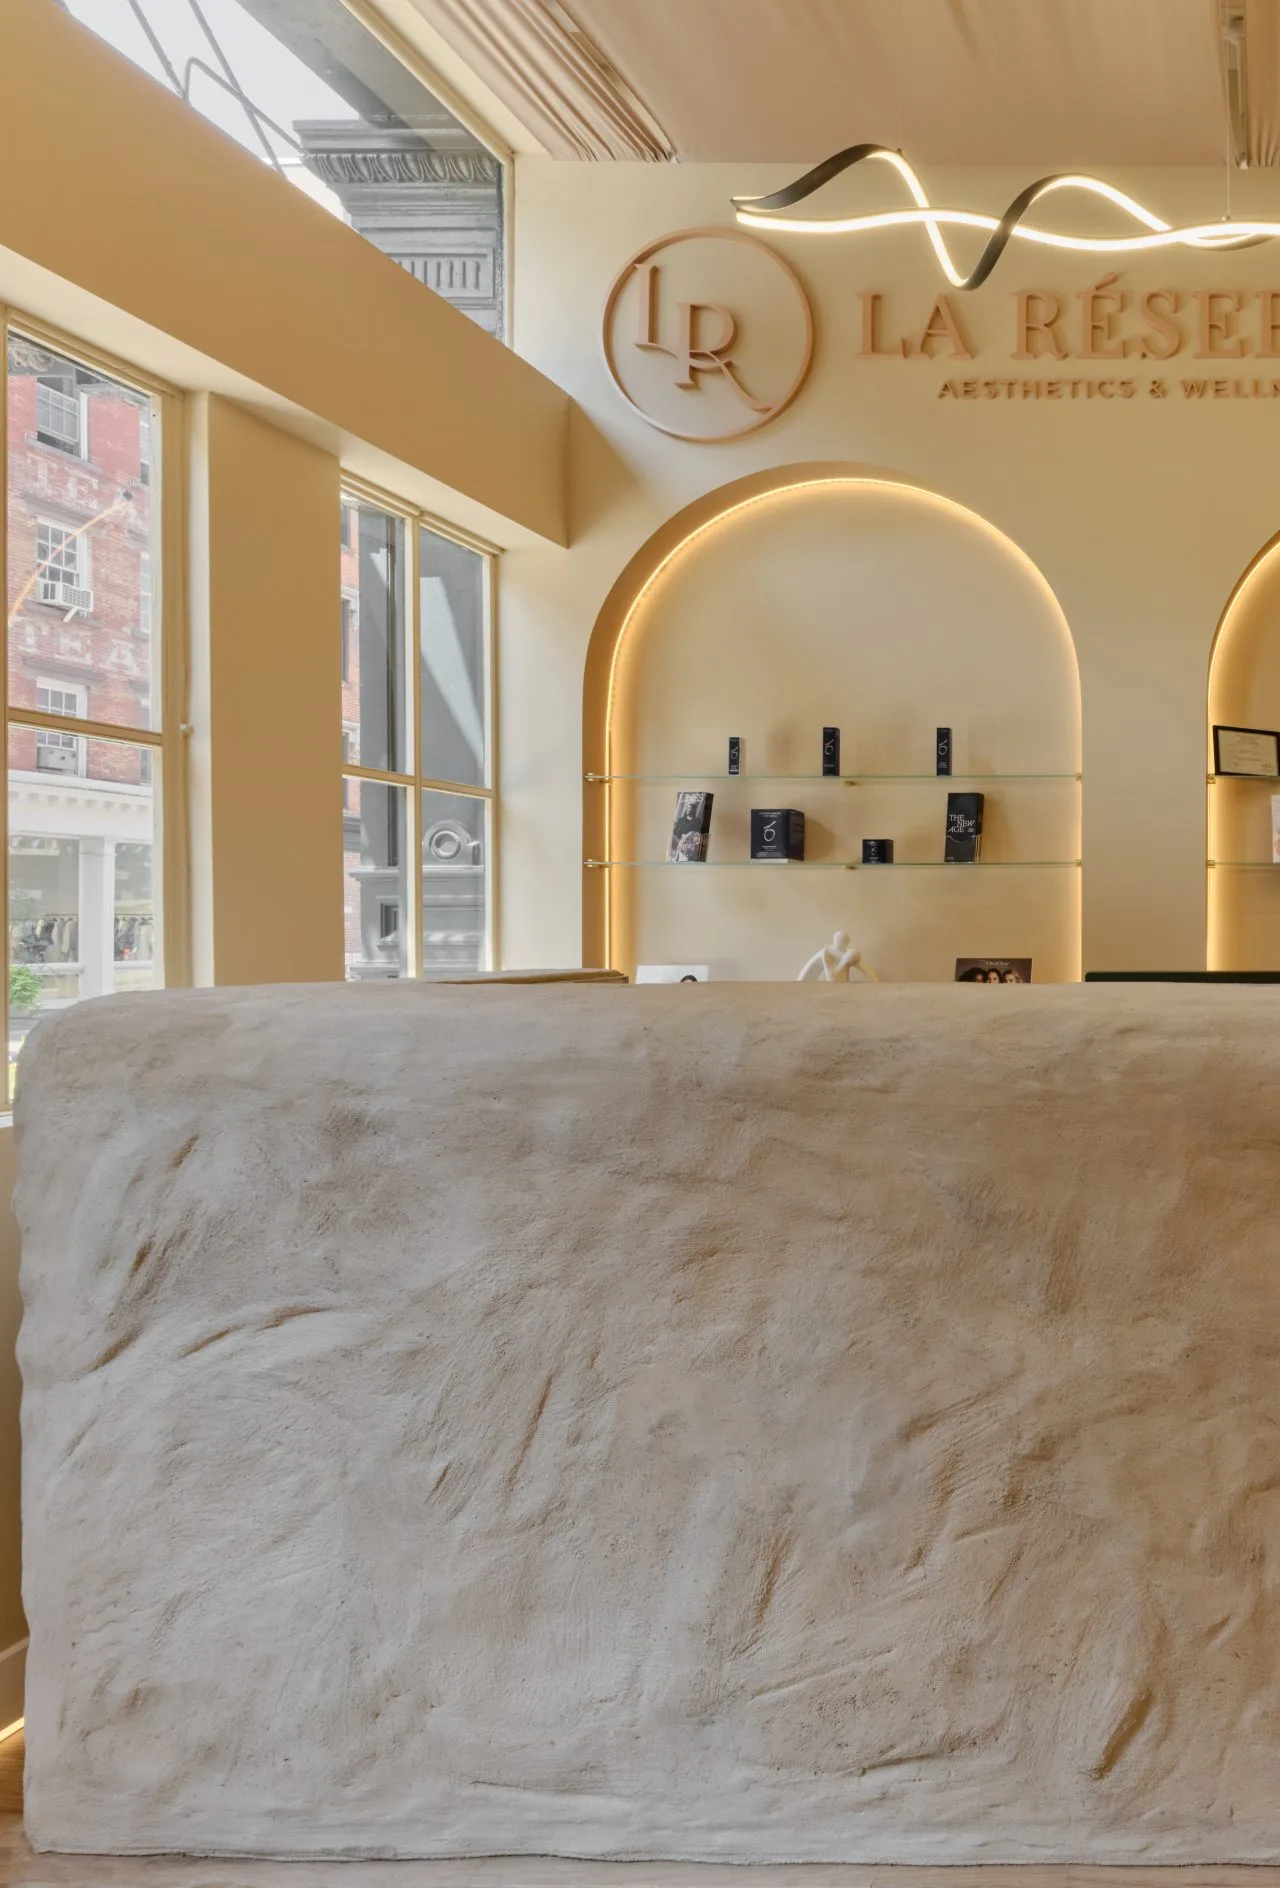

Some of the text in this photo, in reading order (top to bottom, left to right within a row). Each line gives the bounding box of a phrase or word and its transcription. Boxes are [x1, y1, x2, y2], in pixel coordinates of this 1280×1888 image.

[855, 291, 975, 359] LA
[938, 378, 1136, 399] AESTHETICS
[1149, 378, 1165, 398] &
